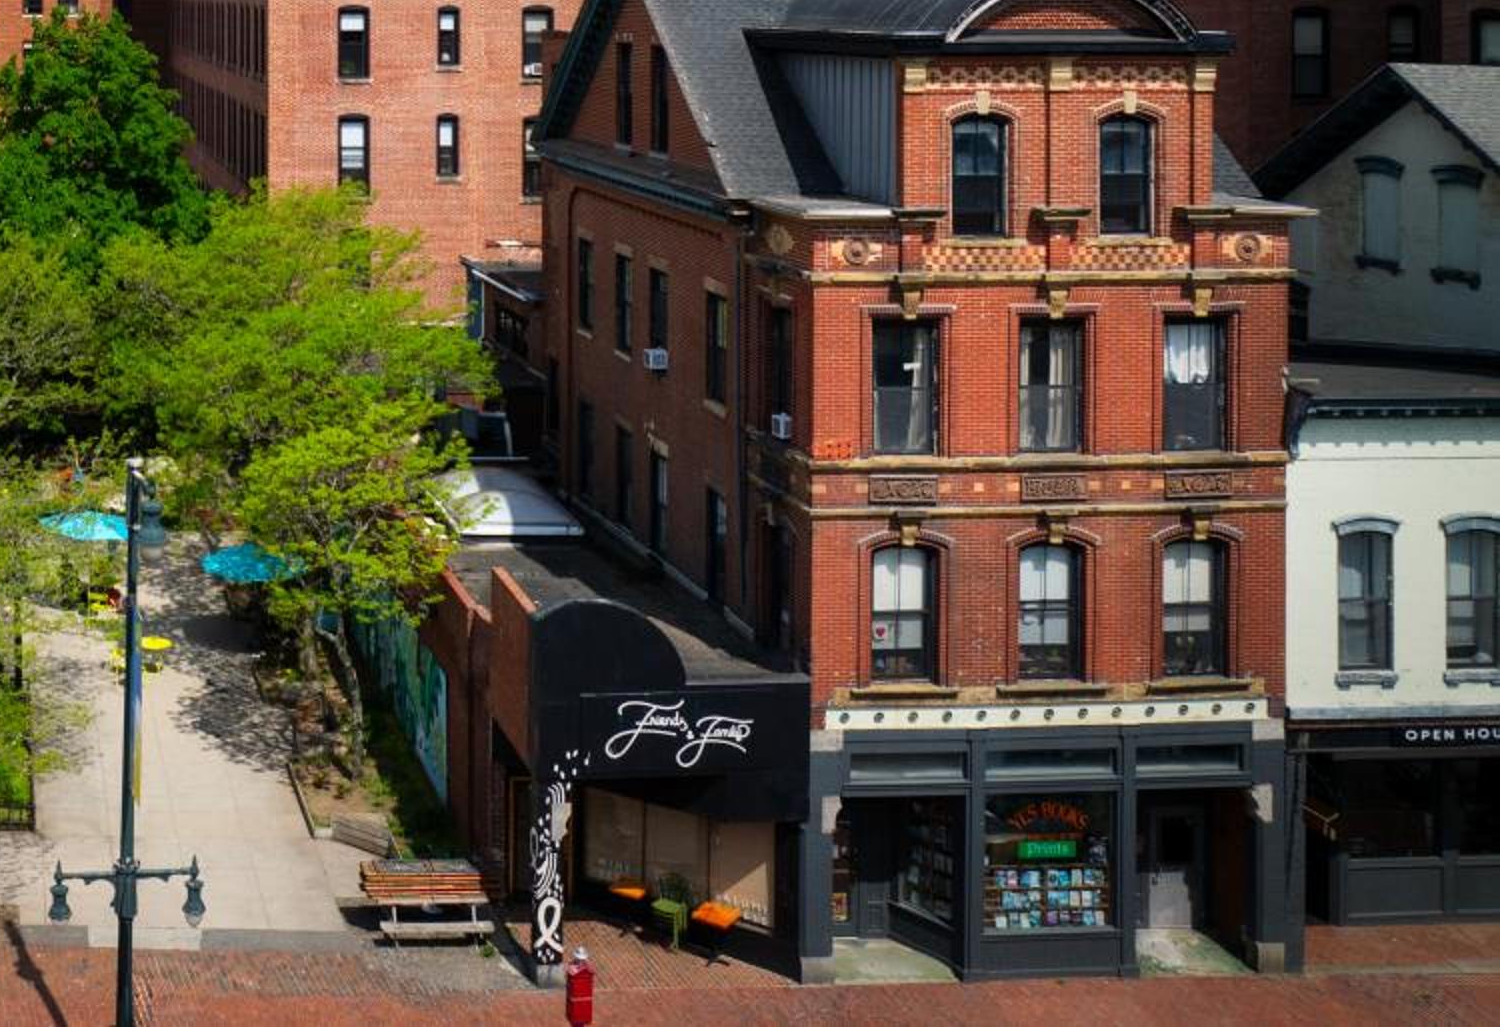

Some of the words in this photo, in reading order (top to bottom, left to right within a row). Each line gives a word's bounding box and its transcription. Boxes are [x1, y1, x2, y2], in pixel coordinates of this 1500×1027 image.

[605, 698, 688, 759] Friends
[1405, 729, 1455, 741] OPEN
[1041, 800, 1090, 830] BOOKS
